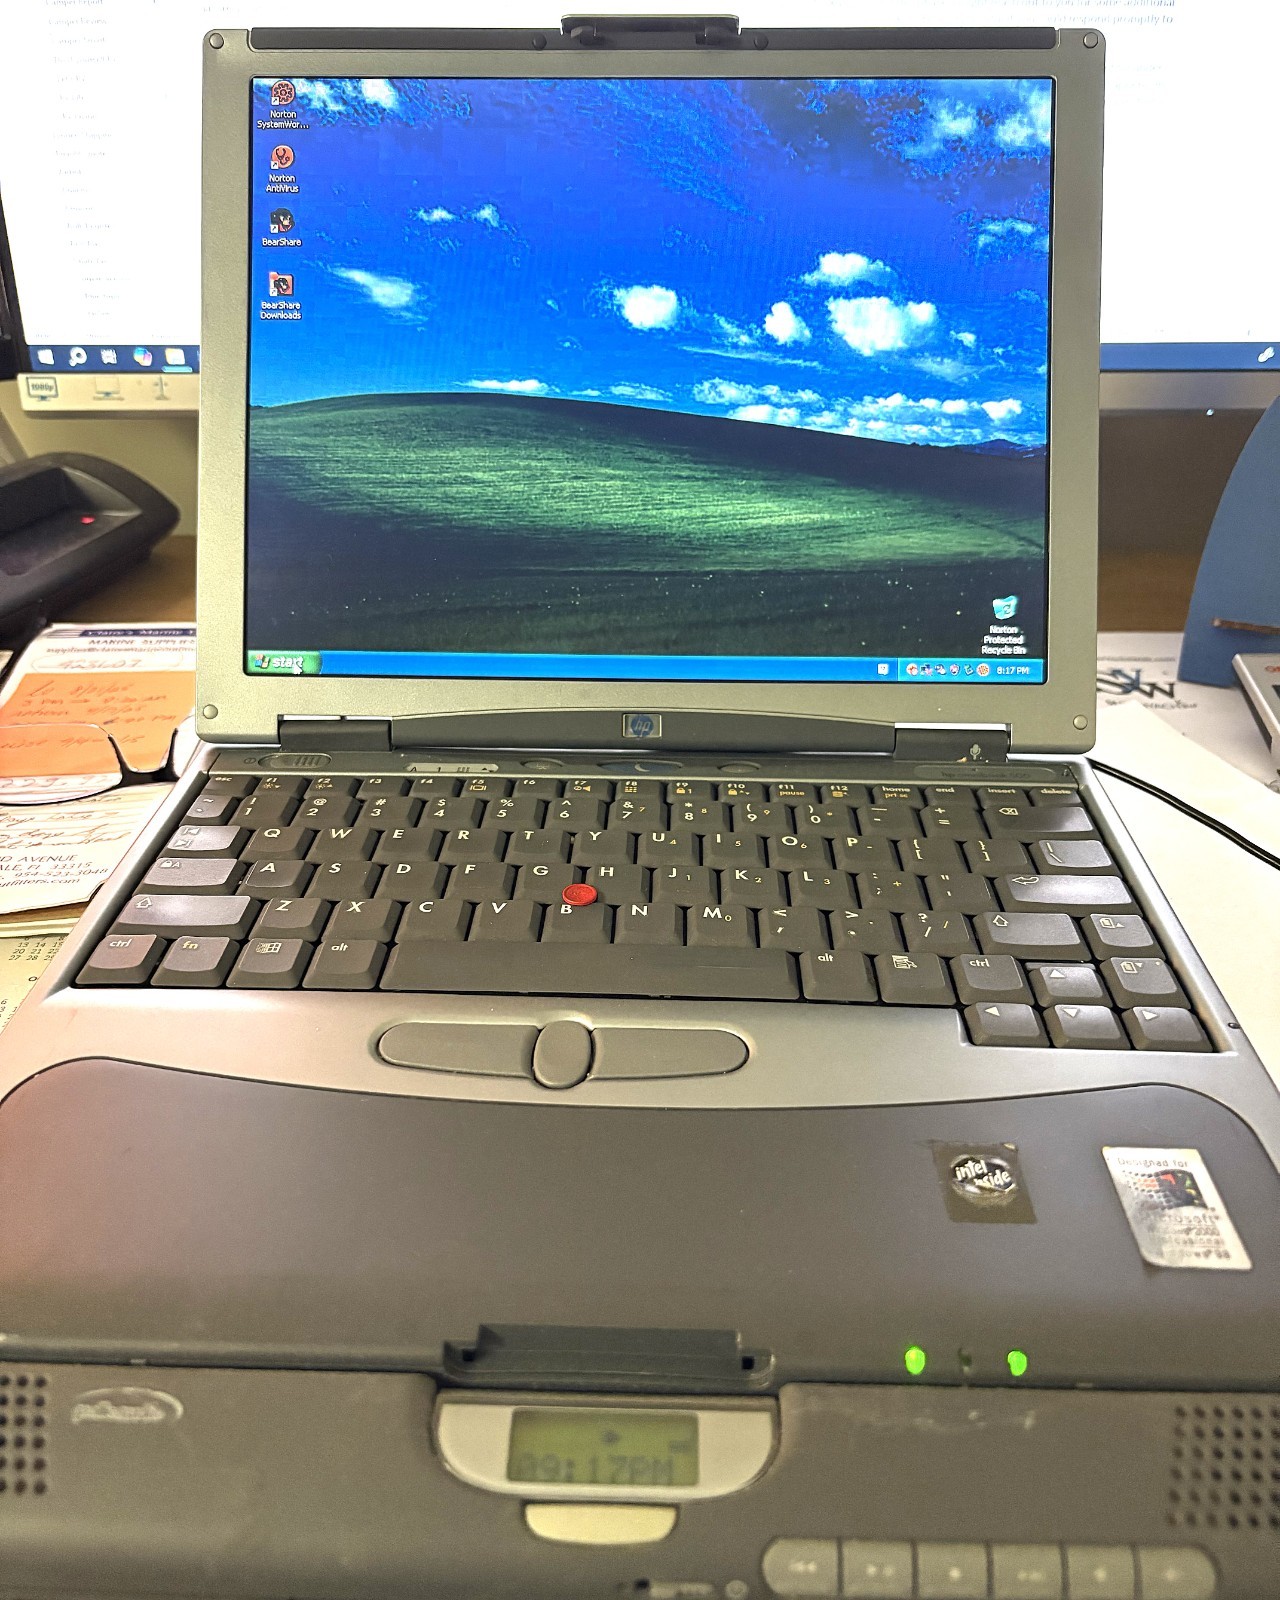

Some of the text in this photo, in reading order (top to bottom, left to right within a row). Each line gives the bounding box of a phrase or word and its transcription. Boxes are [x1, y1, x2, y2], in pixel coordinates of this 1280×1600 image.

[1162, 14, 1174, 24] to
[270, 110, 297, 118] Norton
[269, 174, 296, 183] Norton
[266, 185, 299, 193] AntiVirus
[262, 237, 302, 246] BearShare
[261, 301, 301, 310] BearShare
[260, 311, 302, 320] Downloads
[989, 625, 1018, 634] Norton
[983, 635, 1024, 644] Protected
[981, 645, 1027, 655] Recycle Bin
[272, 656, 304, 668] start
[996, 666, 1030, 675] 8:17 PM
[306, 808, 319, 816] 2
[370, 808, 382, 817] 3
[433, 809, 446, 817] 4
[496, 809, 508, 818] 5
[559, 810, 570, 818] 6
[622, 811, 633, 819] 7
[684, 812, 694, 821] 8
[747, 813, 758, 822] 9
[264, 828, 281, 839] Q
[331, 828, 352, 839] W
[392, 829, 405, 839] E
[457, 830, 470, 840] R
[524, 831, 535, 840] T
[589, 831, 602, 841] Y
[652, 832, 666, 842] U
[781, 836, 798, 846] O
[846, 837, 858, 847] P
[17, 854, 79, 863] AVENUE
[50, 861, 93, 870] 33315
[259, 862, 276, 873] A
[328, 862, 342, 873] S
[396, 864, 411, 874] D
[464, 864, 477, 875] F
[533, 865, 549, 876] G
[600, 866, 614, 877] H
[668, 867, 677, 878] J
[735, 869, 750, 881] K
[803, 871, 813, 882] L
[275, 900, 293, 911] Z
[347, 901, 366, 913] X
[419, 901, 434, 913] C
[492, 902, 508, 914] V
[560, 904, 573, 914] B
[631, 905, 648, 916] N
[703, 906, 723, 919] M
[109, 938, 132, 948] ctrl
[182, 940, 199, 950] fn
[331, 942, 349, 952] alt
[817, 952, 834, 962] alt
[969, 958, 990, 968] ctrl
[1173, 1158, 1189, 1168] for
[955, 1159, 988, 1181] intel
